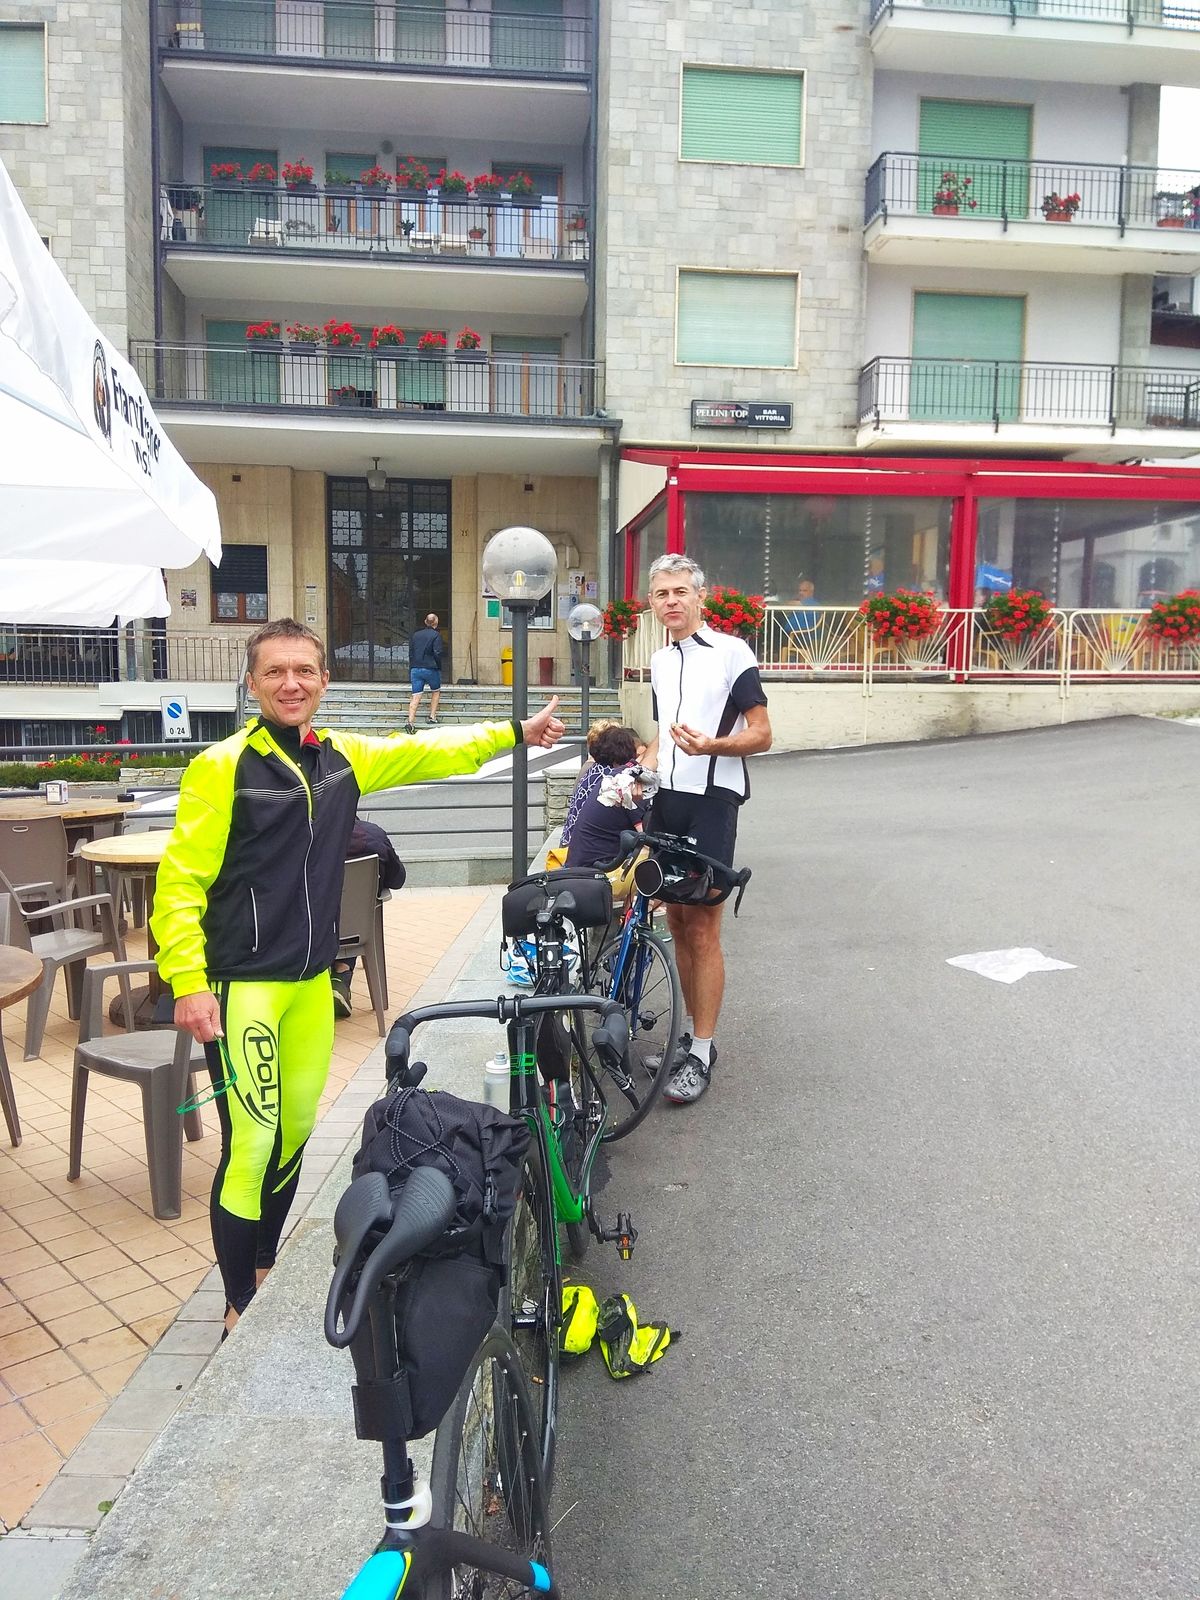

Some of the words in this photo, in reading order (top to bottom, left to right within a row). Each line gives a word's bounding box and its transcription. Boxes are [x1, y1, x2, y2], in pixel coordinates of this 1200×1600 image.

[696, 408, 728, 418] PELLINI
[731, 409, 749, 419] TOP
[169, 727, 175, 735] 0
[177, 727, 185, 735] 24
[248, 1035, 277, 1111] POLI
